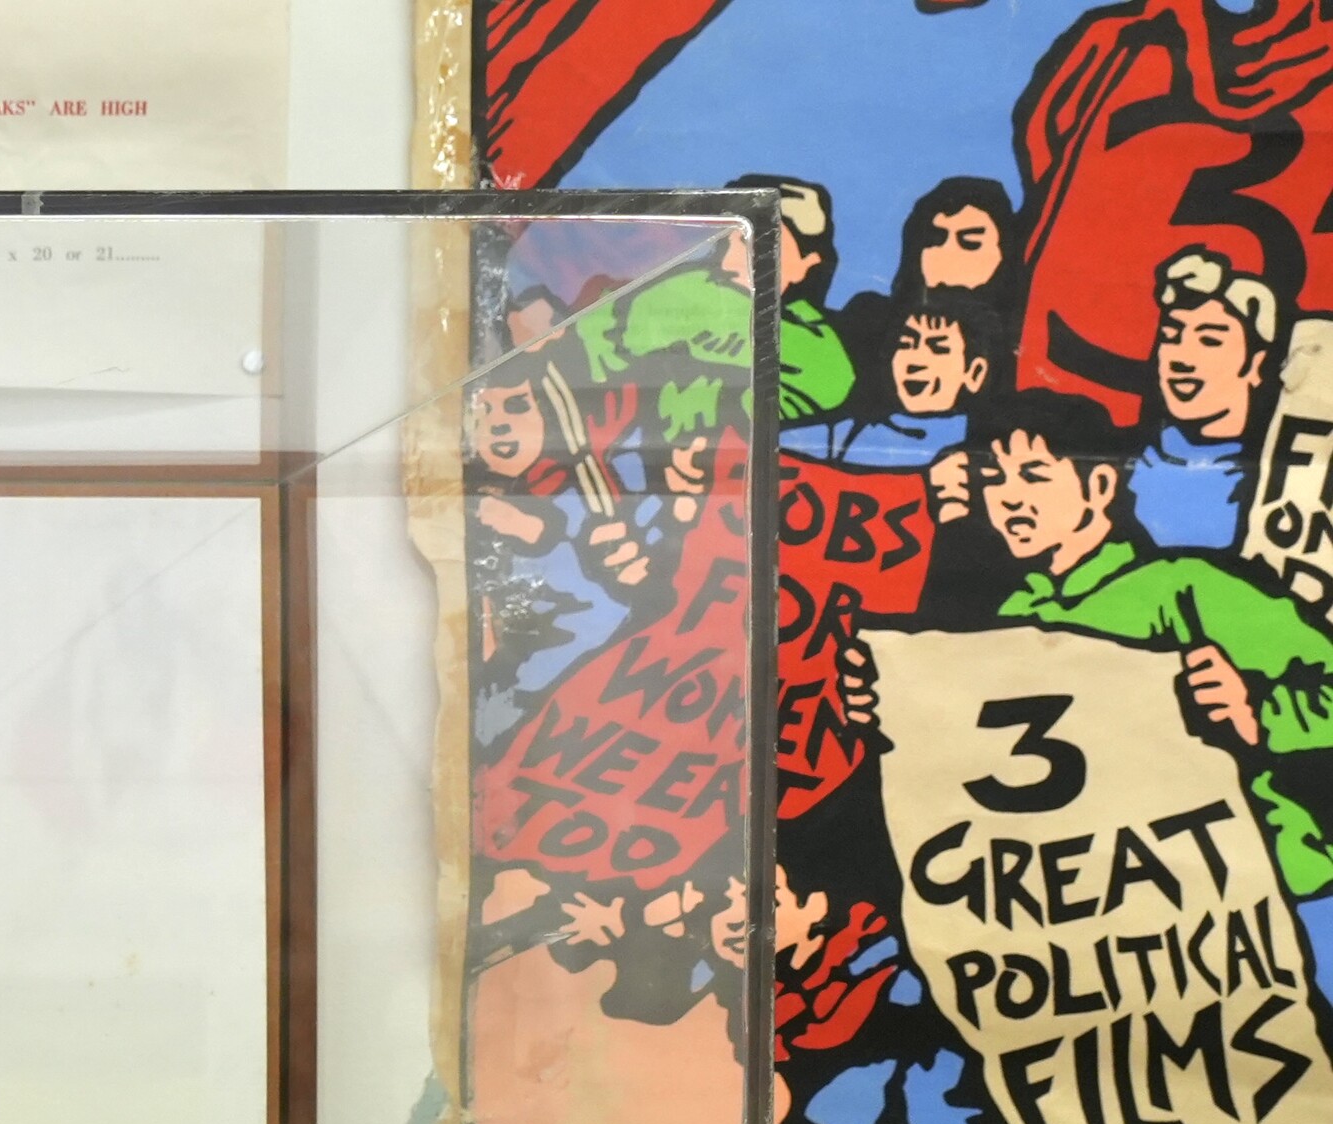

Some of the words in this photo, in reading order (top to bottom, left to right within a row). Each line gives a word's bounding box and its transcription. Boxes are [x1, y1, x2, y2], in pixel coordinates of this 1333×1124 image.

[49, 101, 87, 116] ARE
[100, 100, 148, 116] HIGH
[7, 249, 18, 262] x
[32, 246, 53, 261] 20
[65, 250, 82, 262] or
[523, 700, 660, 794] WE
[963, 695, 1087, 812] 3
[496, 777, 681, 872] TOO
[910, 799, 1235, 927] GREAT
[948, 896, 1296, 1028] POLITICAL
